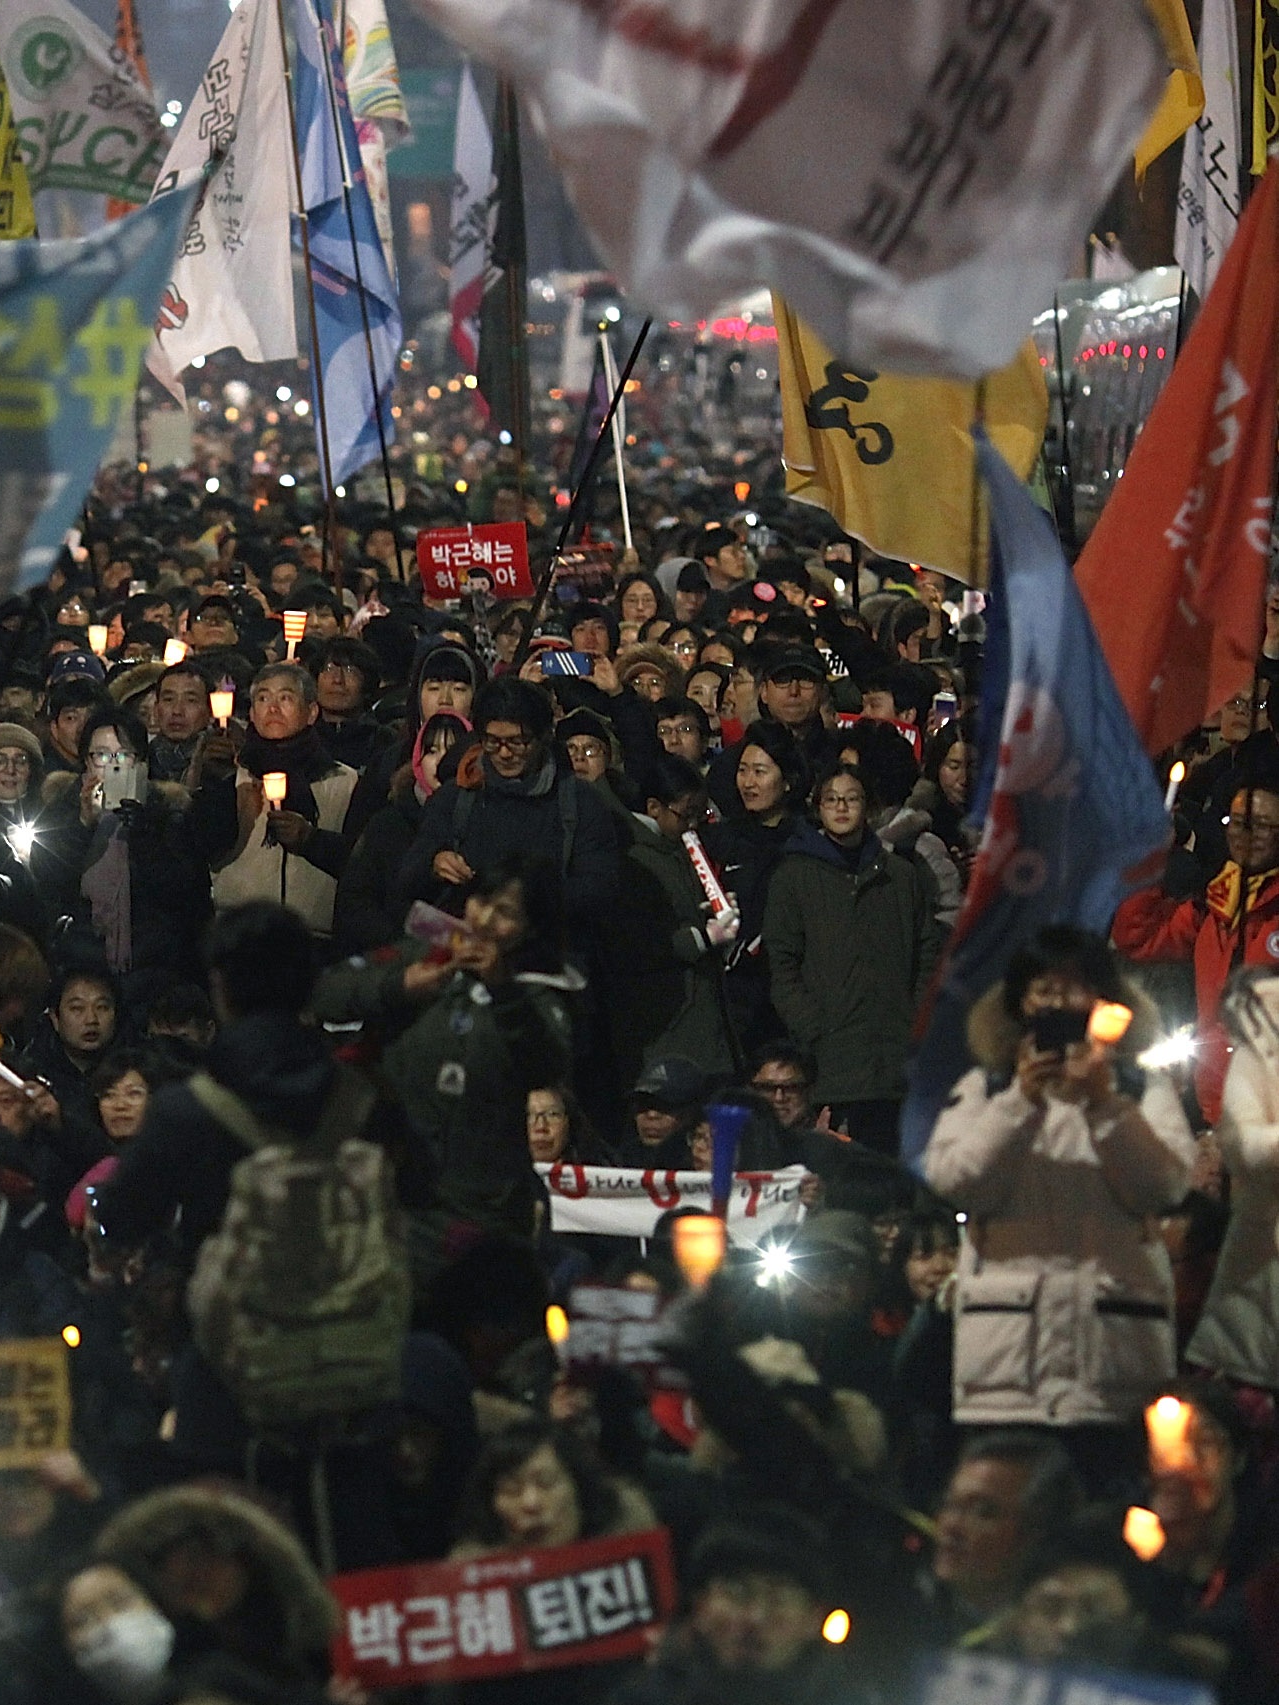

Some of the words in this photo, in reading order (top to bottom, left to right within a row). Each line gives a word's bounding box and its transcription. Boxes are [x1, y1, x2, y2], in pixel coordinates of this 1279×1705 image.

[431, 540, 514, 567] 박근혜는
[347, 1587, 515, 1667] 박근혜
[523, 1557, 655, 1649] 퇴진!
